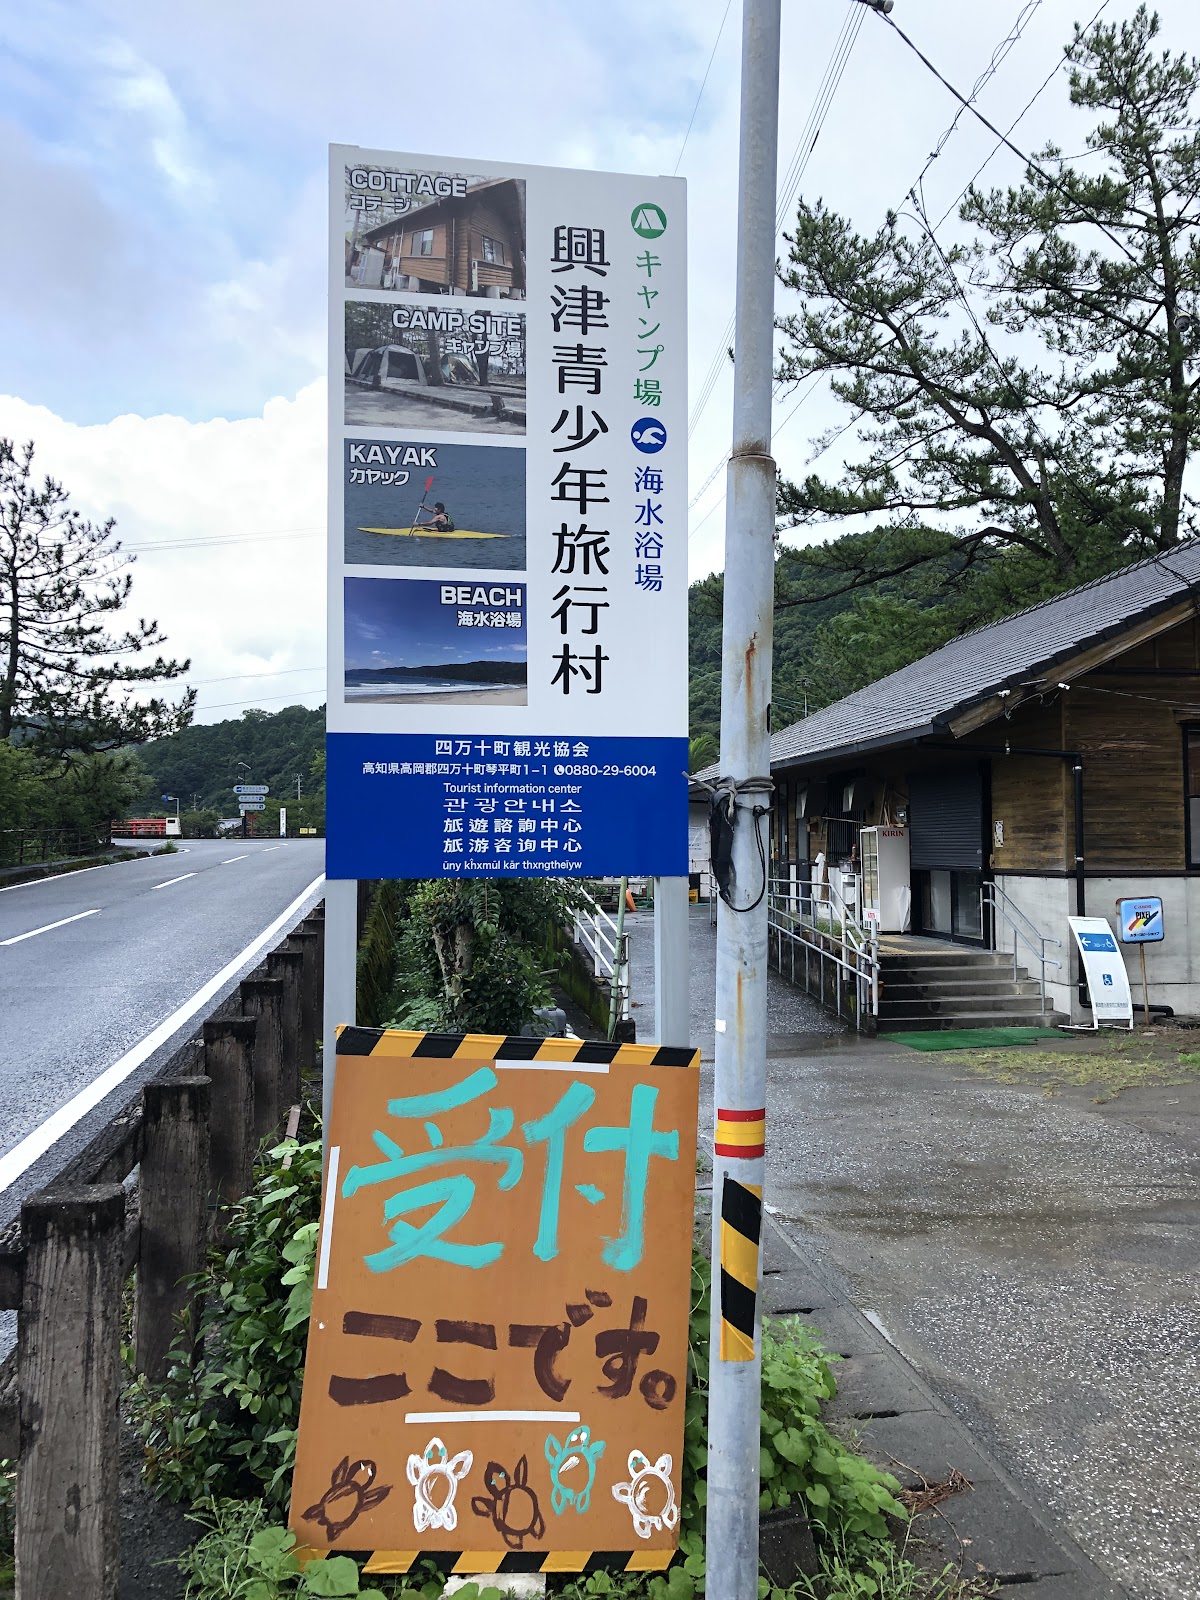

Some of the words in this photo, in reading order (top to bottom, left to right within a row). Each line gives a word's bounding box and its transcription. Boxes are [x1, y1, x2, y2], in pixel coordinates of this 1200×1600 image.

[351, 169, 468, 198] COTTAGE
[350, 194, 412, 213] コテージ
[392, 309, 463, 332] CAMP
[468, 313, 522, 336] SITE
[634, 250, 665, 407] キャンプ場
[446, 338, 522, 358] キャンプ場
[350, 443, 438, 468] KAYAK
[550, 224, 610, 696] 興津青少年旅行村
[349, 467, 410, 487] カヤック
[634, 466, 664, 592] 海水浴場
[440, 585, 523, 607] BEACH
[457, 610, 523, 628] 海水浴場
[435, 739, 590, 758] 四万十町観光協会
[565, 764, 657, 777] 0880-29-6004
[443, 783, 481, 794] Tourist
[484, 783, 545, 795] information
[548, 785, 582, 794] center
[443, 818, 582, 833] 旅遊諮詢中心
[443, 838, 582, 853] 旅游咨询中心
[342, 1066, 679, 1274] 受付
[328, 1288, 677, 1411] ここです。
